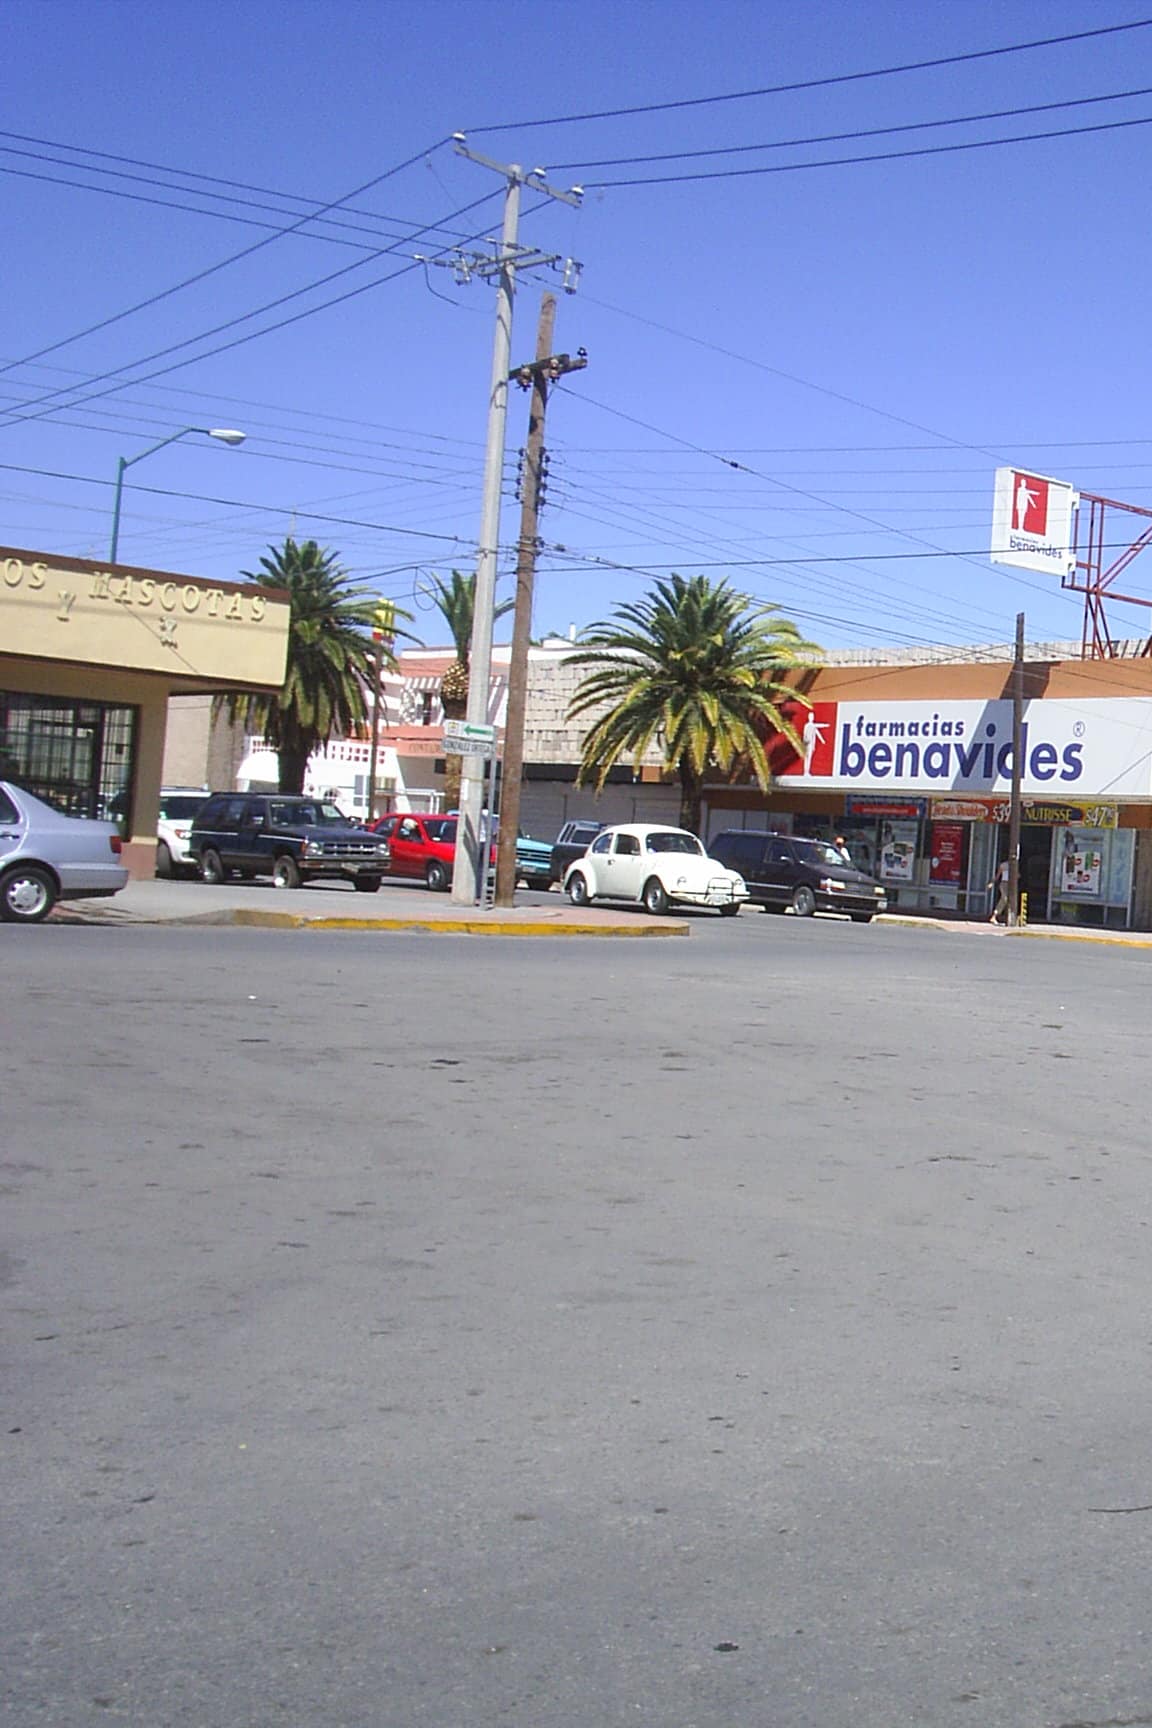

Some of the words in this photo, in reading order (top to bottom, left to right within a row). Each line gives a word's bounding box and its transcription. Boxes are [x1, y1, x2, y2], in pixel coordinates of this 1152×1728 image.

[1009, 535, 1063, 559] benavides
[88, 570, 269, 622] MASCOTAS
[855, 713, 965, 737] farmacias
[838, 721, 1085, 782] benavides
[1025, 806, 1072, 822] NUTRISSE
